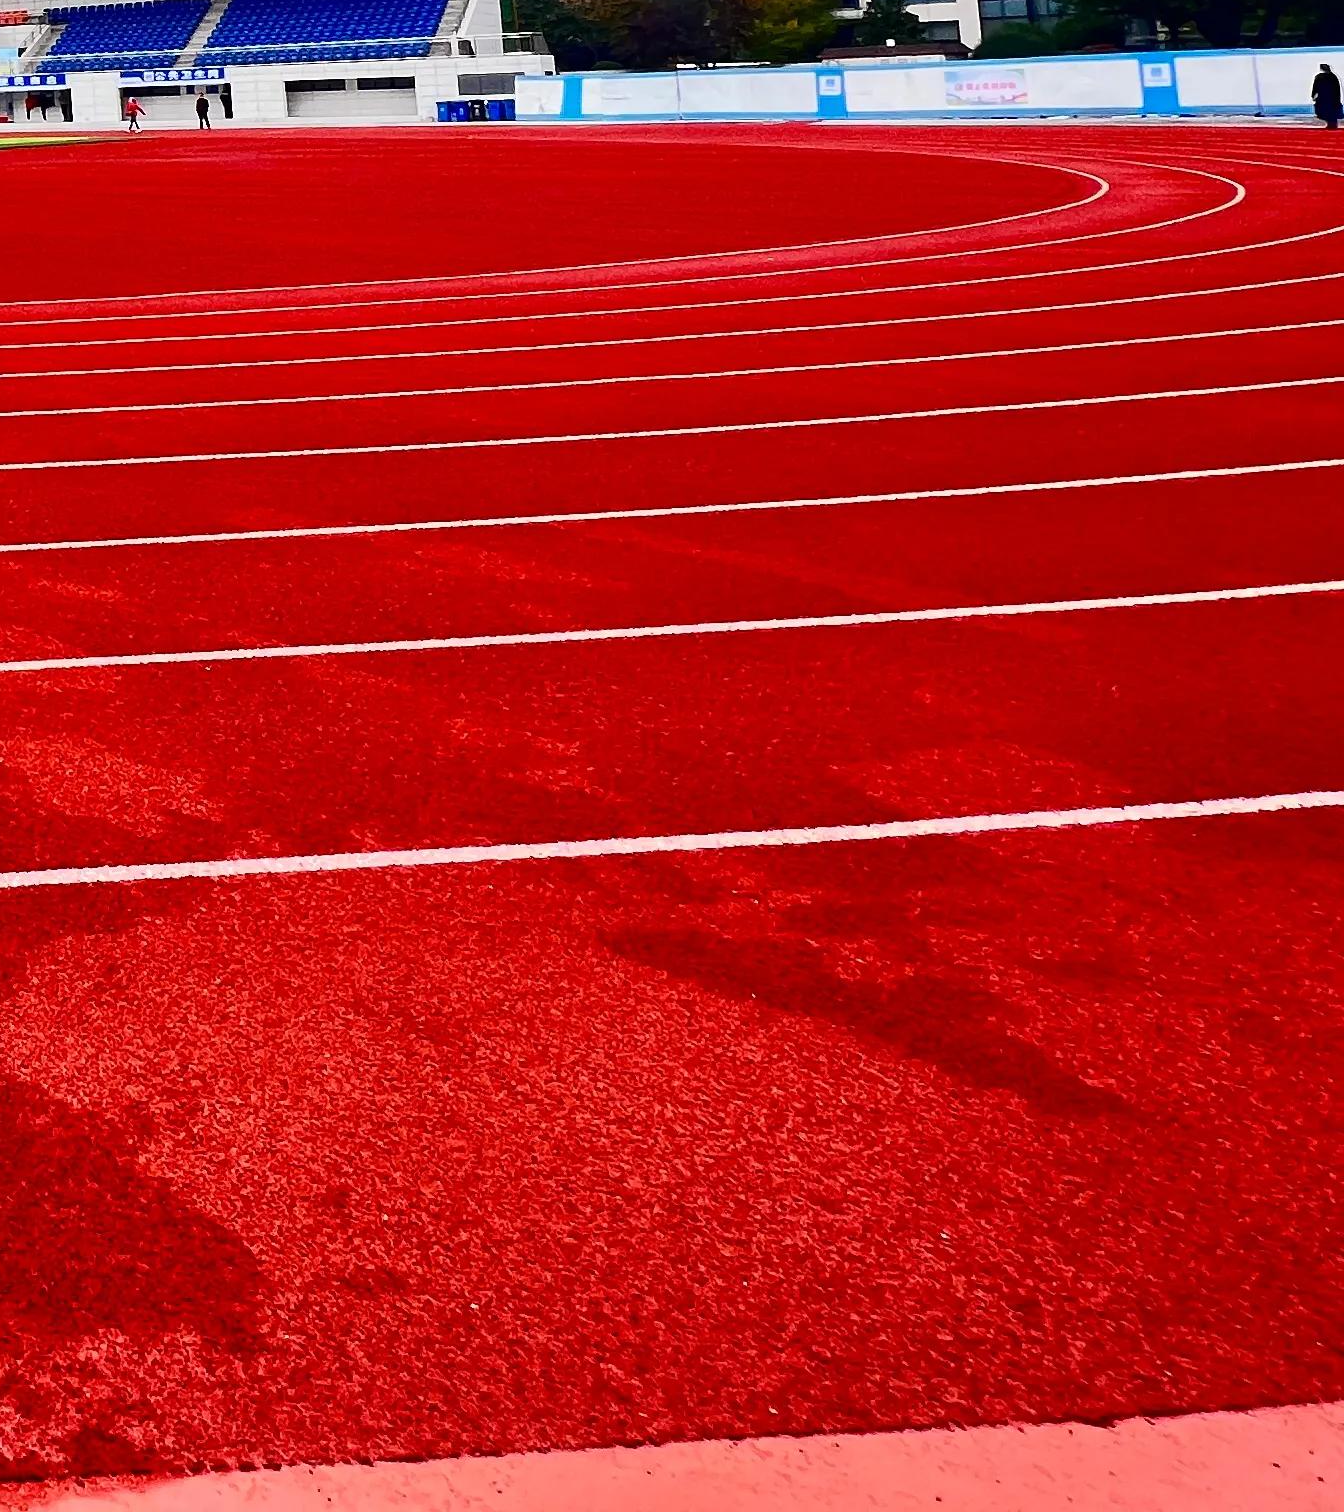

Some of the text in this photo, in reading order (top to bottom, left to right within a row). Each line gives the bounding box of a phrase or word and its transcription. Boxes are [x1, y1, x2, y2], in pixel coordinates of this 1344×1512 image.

[155, 69, 219, 81] 公共卫生间
